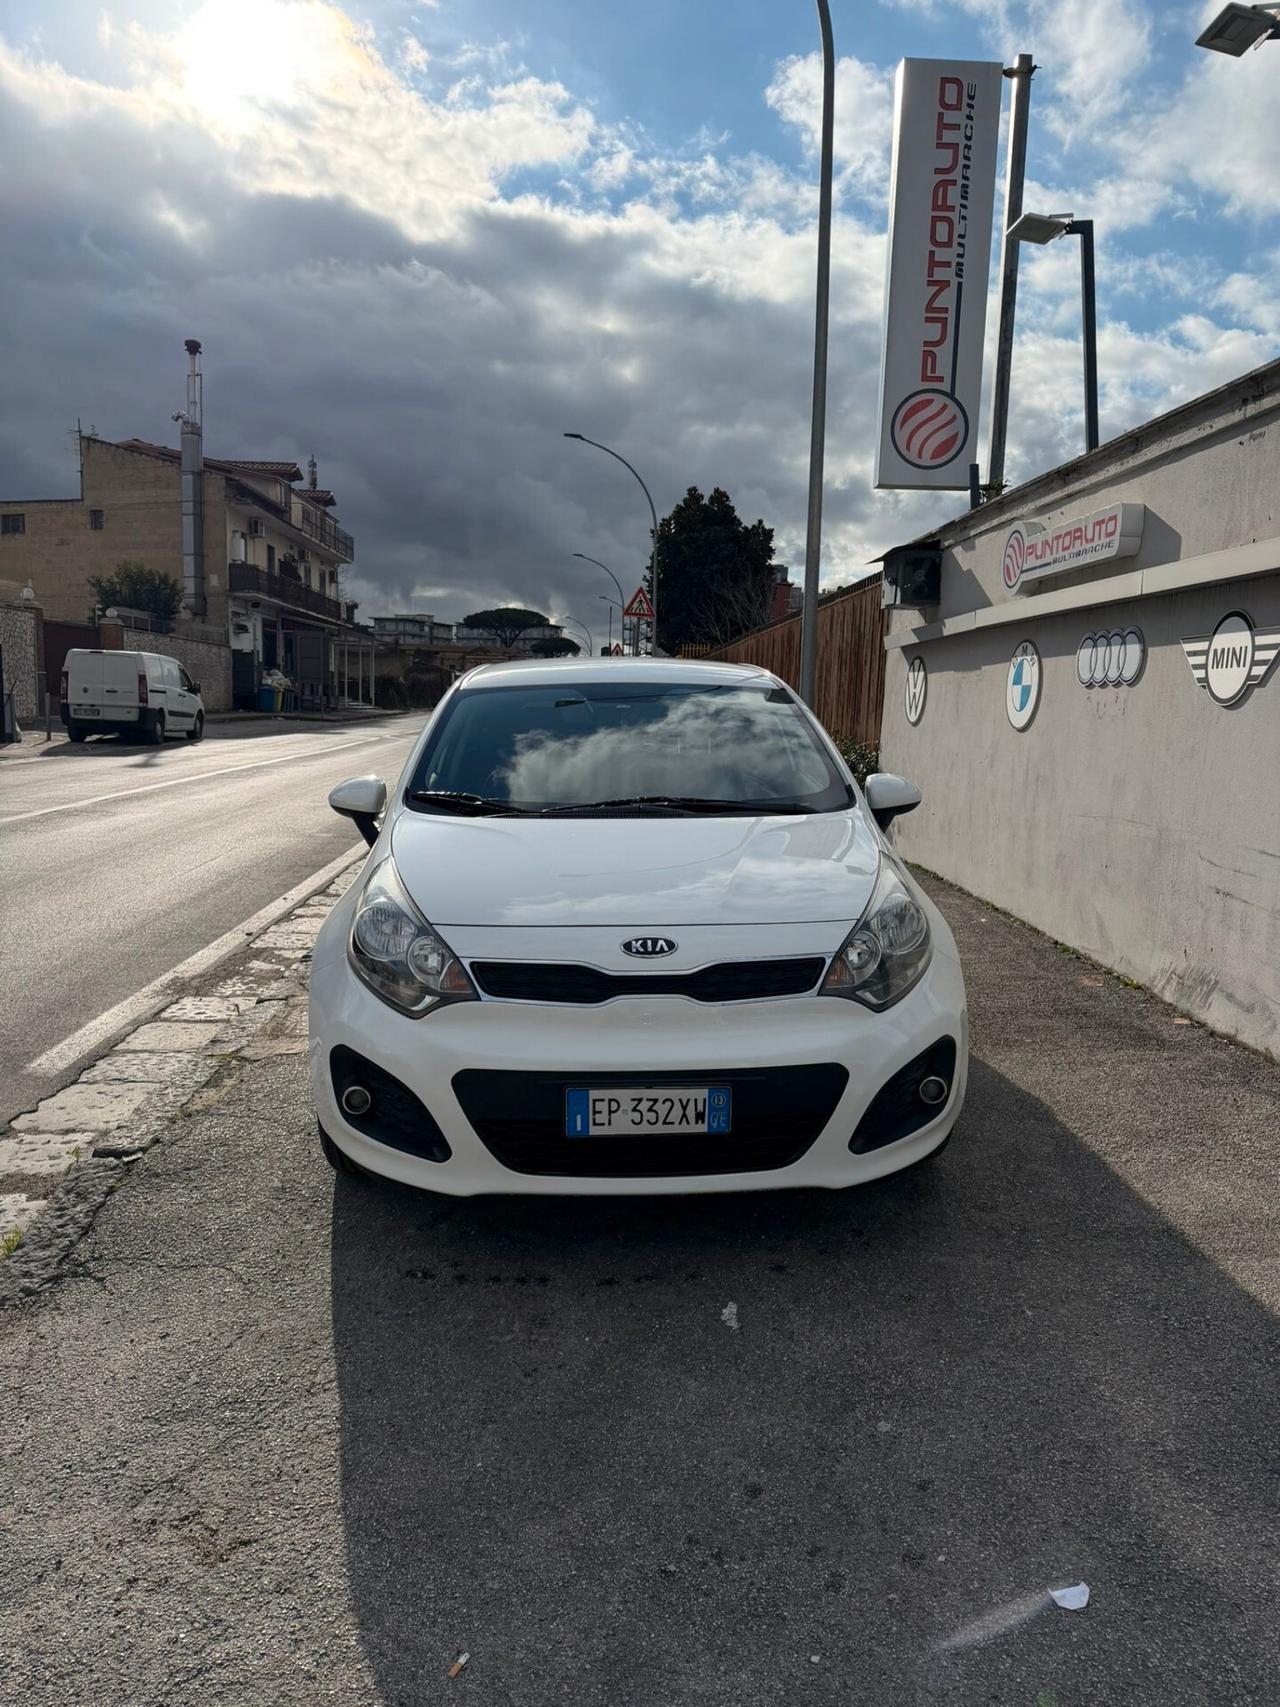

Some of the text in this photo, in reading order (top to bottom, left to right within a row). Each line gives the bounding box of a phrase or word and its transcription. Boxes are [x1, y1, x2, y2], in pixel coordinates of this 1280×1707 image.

[955, 81, 977, 279] MULTIMARCHE
[920, 76, 964, 384] PUNTOAUTO
[1025, 514, 1117, 563] PUNTOAUTO
[1211, 645, 1248, 670] MINI
[631, 939, 669, 952] KIA
[592, 1097, 706, 1126] EP 332XW
